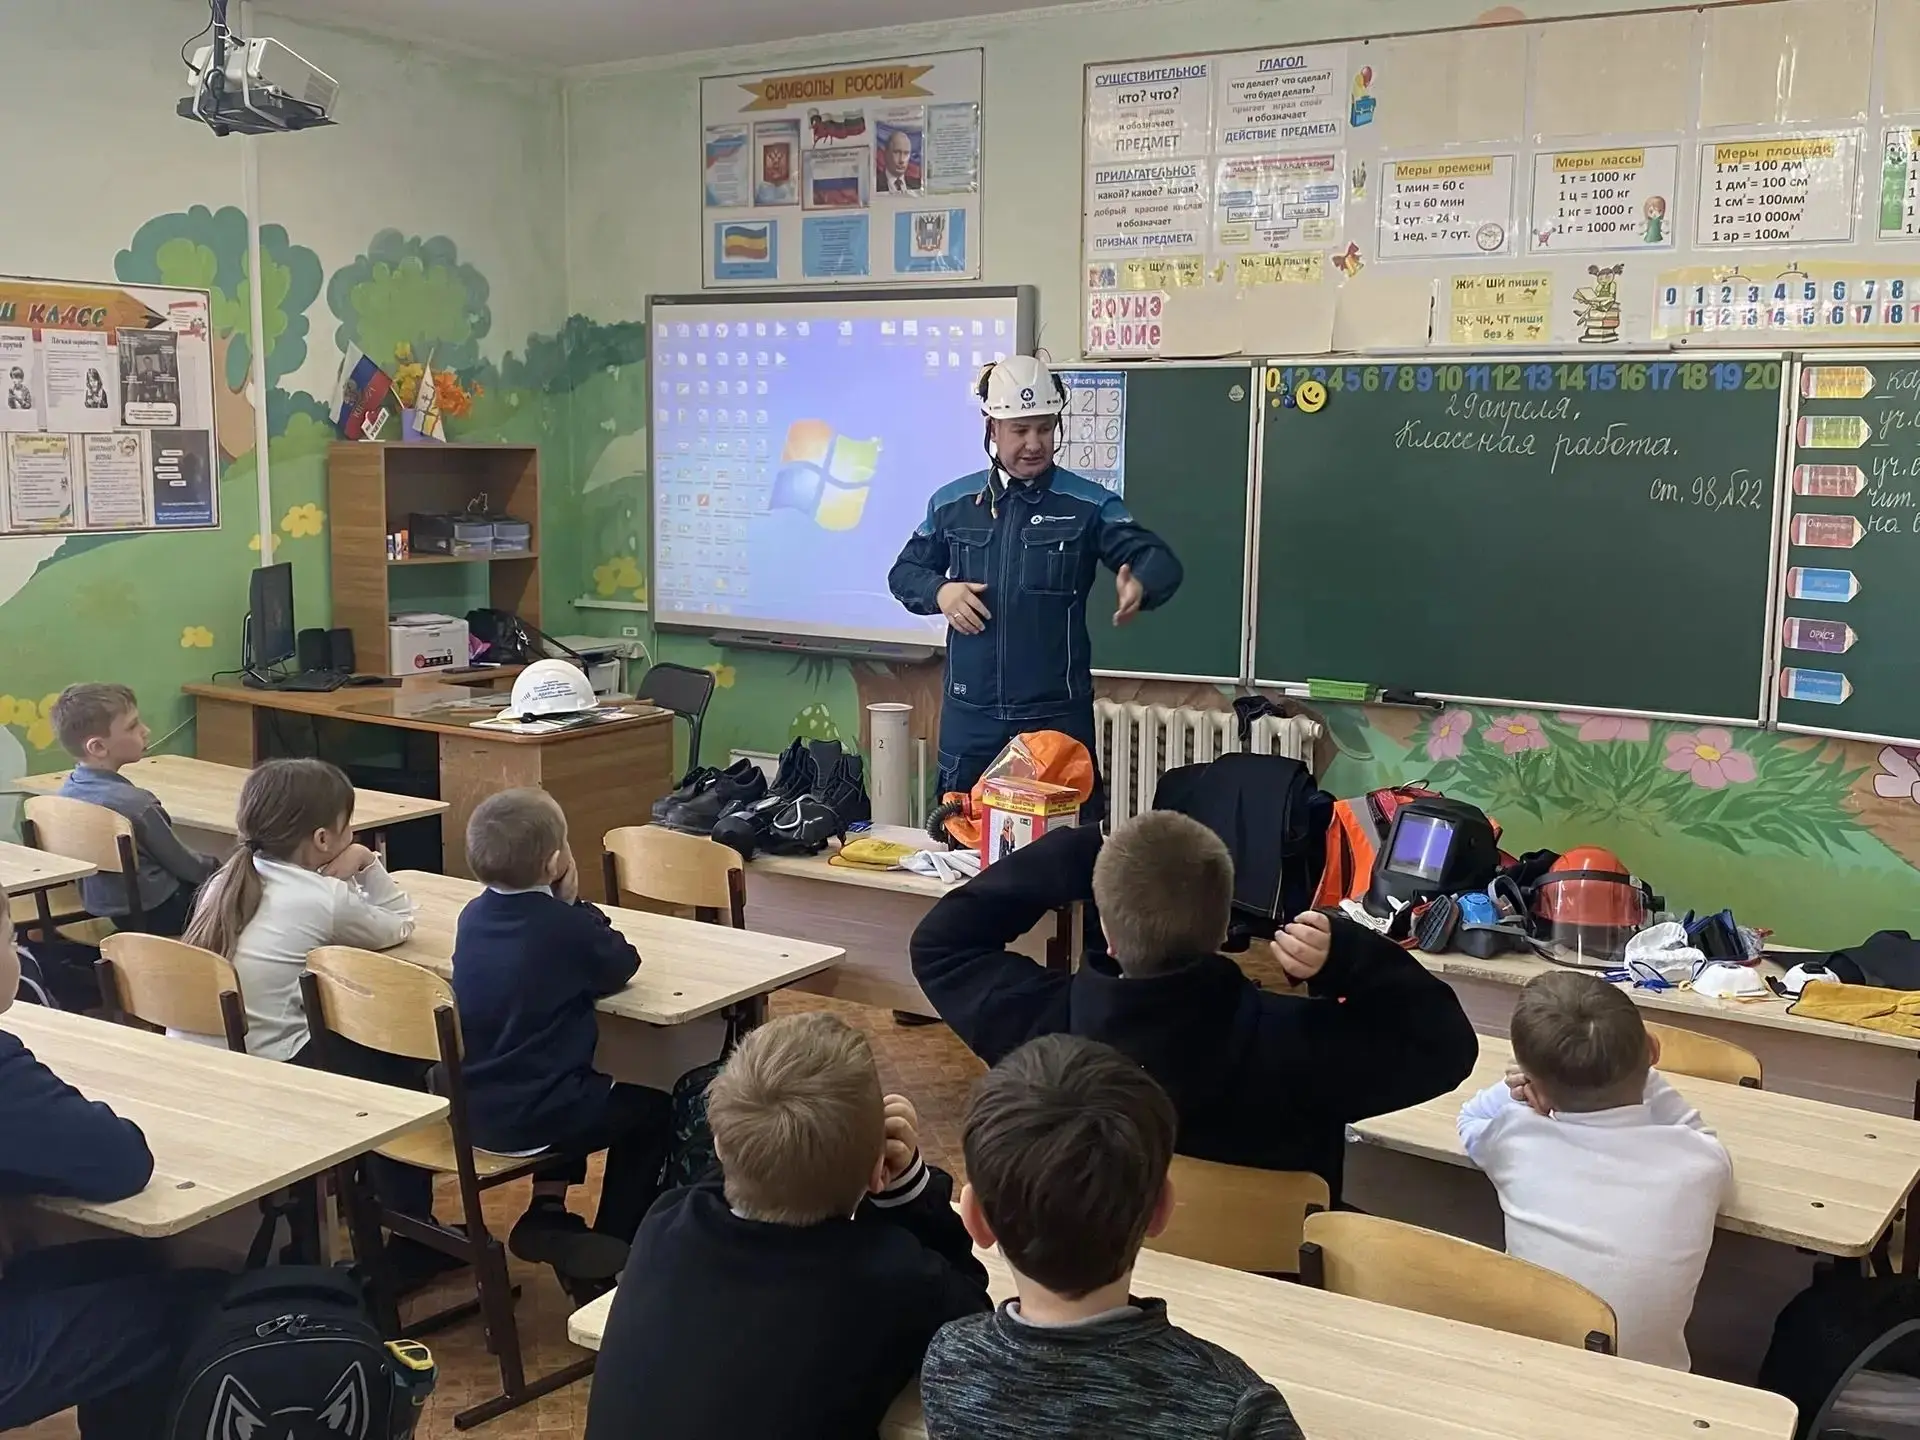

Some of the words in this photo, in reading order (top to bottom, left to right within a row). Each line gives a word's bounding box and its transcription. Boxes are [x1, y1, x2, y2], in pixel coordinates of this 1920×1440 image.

[1259, 56, 1304, 70] ГЛАГОЛ
[1095, 65, 1207, 86] СУЩЕСТВИТЕЛЬНОЕ
[1246, 77, 1279, 89] делает?
[1297, 72, 1331, 84] сделал?
[765, 79, 834, 101] СИМВОЛЫ
[845, 72, 904, 92] РОССИИ
[1258, 90, 1281, 100] будет
[1282, 85, 1316, 98] делать?
[1118, 90, 1147, 104] кто?
[1150, 86, 1179, 101] что?
[1255, 111, 1307, 122] обозначает
[1126, 120, 1174, 130] обозначает
[1225, 129, 1277, 143] ДЕЙСТВИЕ
[1281, 124, 1336, 137] ПРЕДМЕТА
[1116, 134, 1180, 152] ПРЕДМЕТ
[1556, 157, 1594, 169] Меры
[1600, 154, 1641, 165] массы
[1717, 148, 1759, 161] Меры
[1396, 166, 1432, 177] Меры
[1438, 163, 1491, 174] времени
[1717, 163, 1723, 173] 1
[1754, 160, 1778, 172] 100
[1095, 165, 1196, 183] ПРИЛАГАТЕЛЬНОЕ
[1560, 174, 1566, 184] 1
[1590, 172, 1619, 183] 1000
[1623, 172, 1636, 181] кг
[1396, 184, 1402, 193] 1
[1405, 184, 1430, 193] мин
[1442, 181, 1456, 191] 60
[1459, 182, 1465, 190] с
[1715, 181, 1722, 190] 1
[1762, 177, 1786, 188] 100
[1098, 189, 1130, 200] какой?
[1131, 186, 1163, 197] какое?
[1167, 183, 1199, 195] какая?
[1559, 191, 1565, 201] 1
[1569, 193, 1577, 203] ц
[1592, 188, 1613, 200] 100
[1617, 189, 1630, 198] кг
[1395, 201, 1401, 210] 1
[1404, 201, 1411, 209] ч
[1423, 198, 1437, 208] 60
[1440, 198, 1465, 207] мин
[1714, 197, 1721, 207] 1
[1094, 206, 1127, 217] добрый
[1134, 204, 1169, 214] красное
[1558, 207, 1564, 217] 1
[1568, 208, 1581, 217] кг
[1595, 205, 1624, 216] 1000
[1123, 218, 1172, 228] обозначает
[1395, 216, 1401, 225] 1
[1403, 215, 1424, 228] сут.
[1436, 213, 1450, 224] 24
[1557, 224, 1564, 234] 1
[1587, 222, 1616, 233] 1000
[1619, 222, 1636, 232] мг
[1096, 237, 1138, 248] ПРИЗНАК
[1142, 233, 1193, 246] ПРЕДМЕТА
[1393, 232, 1399, 241] 1
[1402, 231, 1428, 243] нед.
[1440, 229, 1448, 239] 7
[1450, 230, 1471, 241] сут.
[1712, 231, 1719, 241] 1
[1723, 232, 1739, 243] ар
[1241, 258, 1254, 267] ЧА
[1264, 257, 1281, 268] ЩА
[1508, 278, 1539, 288] пиши
[1665, 287, 1677, 305] 0
[1695, 286, 1704, 303] 1
[1721, 286, 1732, 303] 2
[1748, 285, 1759, 303] 3
[1774, 283, 1786, 300] 4
[1804, 281, 1816, 300] 5
[1833, 281, 1846, 300] 6
[1865, 280, 1876, 299] 7
[1891, 280, 1904, 299] 8
[28, 303, 108, 328] КЛАСС
[1512, 315, 1544, 324] пиши
[1689, 309, 1704, 326] 11
[1715, 308, 1731, 326] 12
[1767, 307, 1786, 325] 14
[1797, 306, 1815, 324] 15
[1826, 305, 1844, 324] 16
[1855, 305, 1873, 324] 17
[1884, 304, 1903, 324] 18
[1483, 329, 1502, 339] без
[1266, 368, 1281, 393] 0
[1327, 367, 1347, 392] 4
[1345, 367, 1362, 392] 5
[1363, 367, 1380, 392] 6
[1381, 367, 1398, 392] 7
[1399, 366, 1415, 392] 8
[1416, 366, 1434, 392] 9
[1434, 366, 1463, 392] 10
[1465, 366, 1491, 391] 11
[1491, 365, 1521, 391] 12
[1523, 364, 1553, 391] 13
[1555, 364, 1587, 391] 14
[1586, 363, 1617, 391] 15
[1616, 363, 1647, 392] 16
[1646, 363, 1678, 391] 17
[1677, 362, 1708, 391] 18
[1710, 362, 1742, 391] 19
[1744, 362, 1781, 391] 20
[1020, 402, 1037, 411] АЭР
[1081, 390, 1095, 413] 2
[1106, 390, 1120, 413] 3
[1081, 417, 1094, 440] 5
[1105, 417, 1119, 440] 6
[1394, 419, 1537, 454] Классная
[1550, 422, 1680, 475] работа.
[1079, 445, 1093, 468] 8
[1104, 445, 1118, 468] 9
[878, 739, 884, 749] 2
